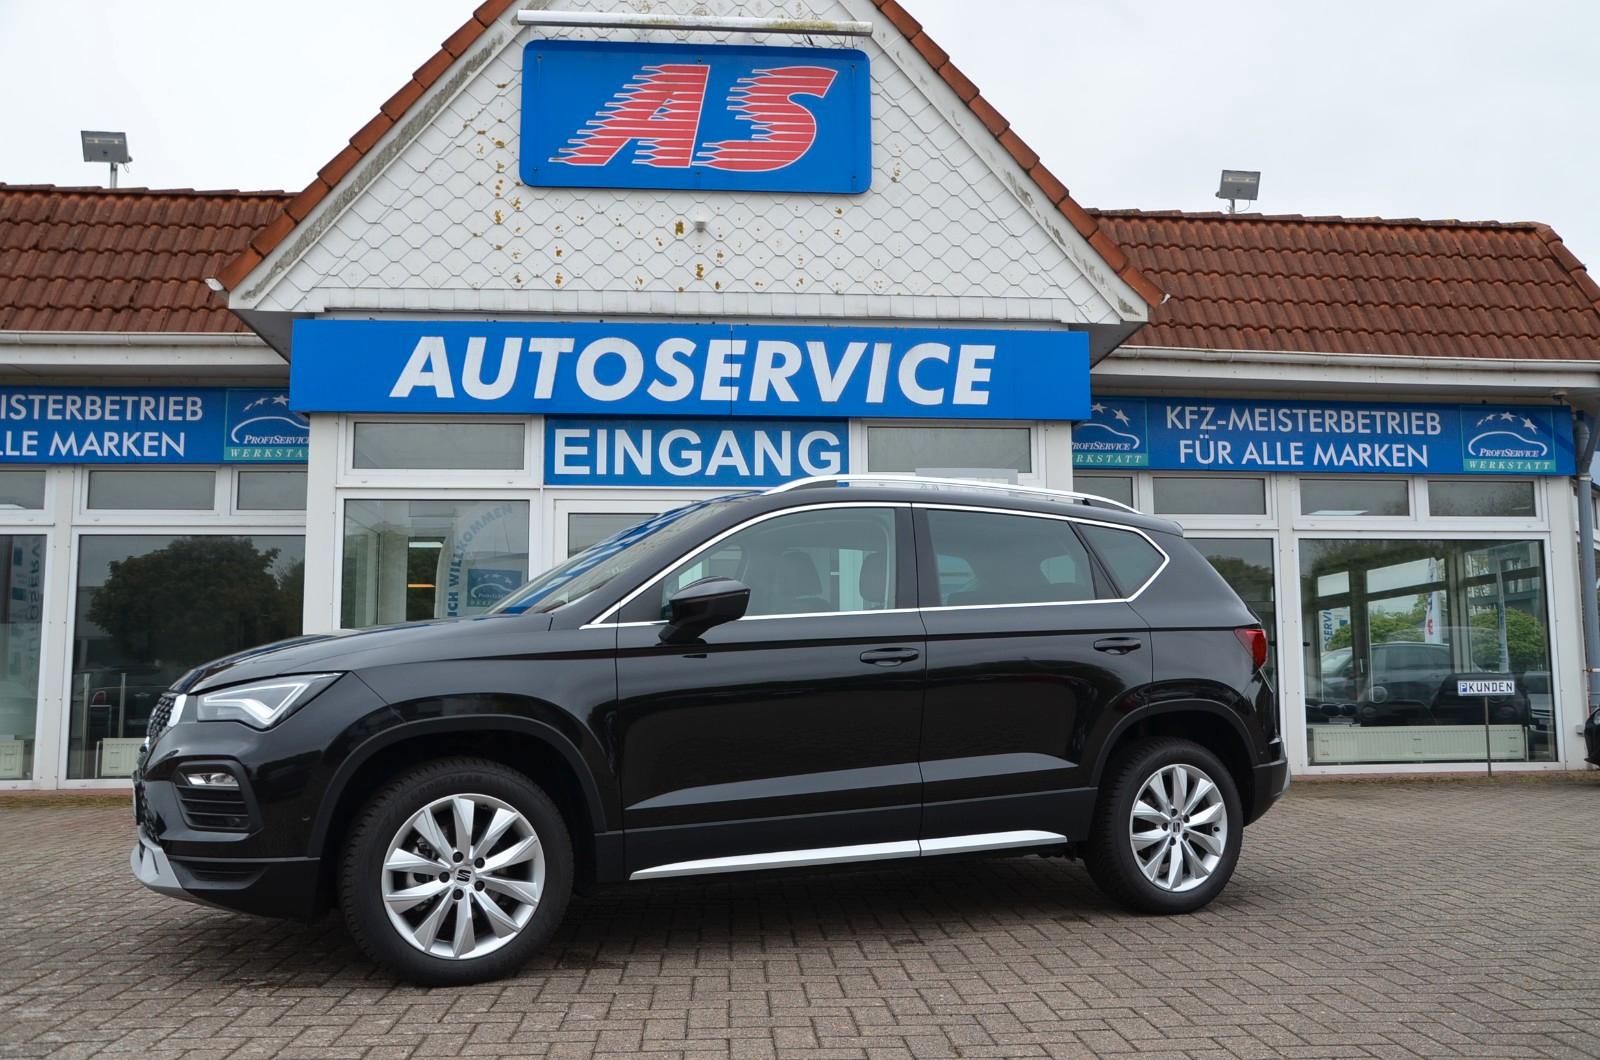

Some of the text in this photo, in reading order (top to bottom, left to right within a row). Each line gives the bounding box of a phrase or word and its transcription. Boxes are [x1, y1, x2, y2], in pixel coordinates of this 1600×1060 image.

[548, 64, 838, 172] AS
[388, 336, 996, 406] AUTOSERVICE
[1, 394, 203, 421] ISTERBETRIEB
[1166, 406, 1441, 435] KFZ-MEISTERBETRIEB
[0, 431, 185, 457] LE MARKEN
[231, 448, 309, 458] WERKSTA
[554, 429, 841, 477] EINGANG
[1179, 434, 1429, 468] FÜR ALLE MARKEN
[1072, 454, 1142, 464] RKSTATT
[1469, 460, 1550, 470] WERKSTATT
[1469, 682, 1513, 693] KUNDEN
